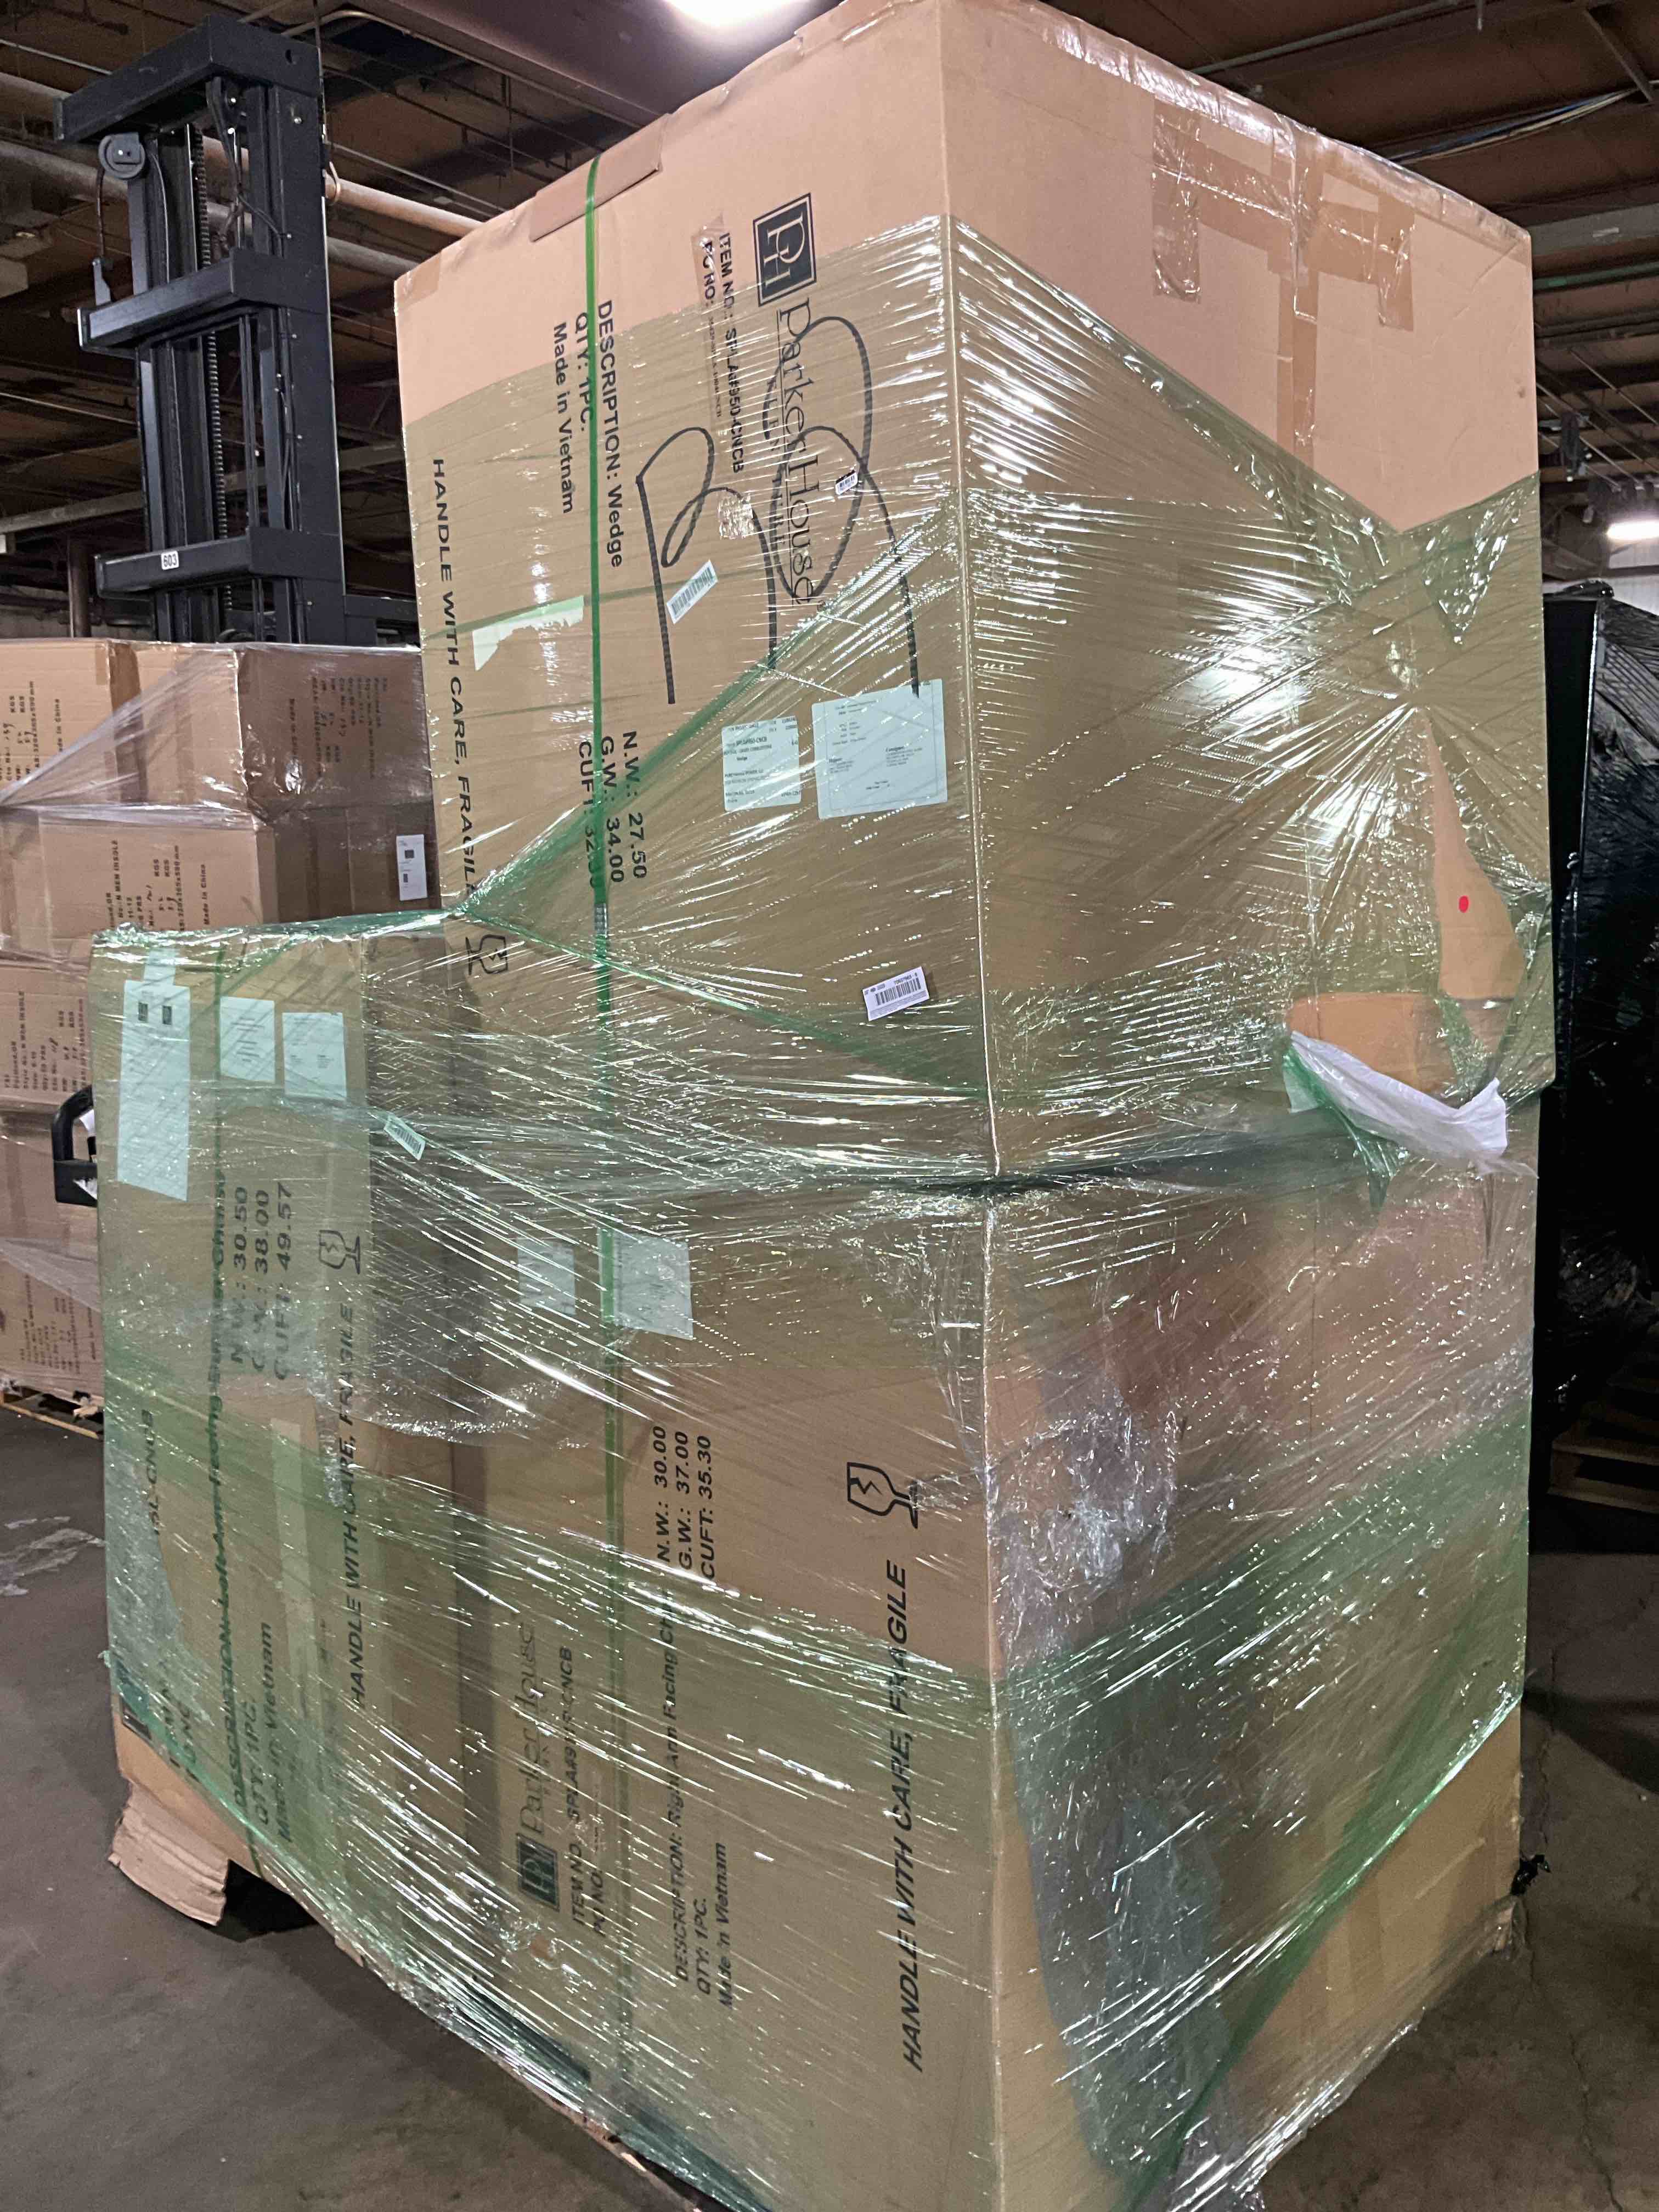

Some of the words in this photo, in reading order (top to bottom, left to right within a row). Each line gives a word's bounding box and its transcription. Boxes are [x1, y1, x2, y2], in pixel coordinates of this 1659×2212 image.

[704, 274, 716, 305] NO:
[719, 234, 733, 278] ITEM
[552, 323, 569, 385] Made
[556, 393, 571, 414] in
[598, 301, 620, 479] DESCRIPTION:
[557, 419, 575, 514] Vietnam
[432, 459, 453, 582] HANDLE
[607, 485, 625, 568] Wedge
[163, 554, 177, 567] 603
[443, 591, 460, 666] WITH
[449, 677, 468, 766] CARE,
[601, 736, 617, 802] G.W.:
[623, 731, 641, 798] N.W.:
[606, 817, 624, 883] 34.00
[629, 812, 647, 878] 27.50
[233, 1187, 247, 1271] 30.50
[254, 1190, 269, 1274] 38.00
[277, 1182, 291, 1271] 49.57
[652, 1425, 668, 1488] 30.00
[675, 1431, 690, 1494] 37.00
[697, 1435, 713, 1499] 35.30
[343, 1522, 360, 1589] WITH
[655, 1501, 670, 1562] N.W.:
[677, 1508, 692, 1570] G.W.:
[698, 1509, 715, 1579] CUFT:
[260, 1623, 278, 1729] Vietnam
[346, 1596, 366, 1708] HANDLE
[662, 1651, 678, 1719] Facing
[889, 1728, 915, 1832] CARE,
[571, 1878, 585, 1926] ITEM
[714, 1842, 729, 1924] Vietnam
[893, 1839, 917, 1927] WITH
[693, 1897, 708, 1940] 1PC.
[695, 1946, 711, 1995] QTY:
[896, 1929, 923, 2072] HANDLE
